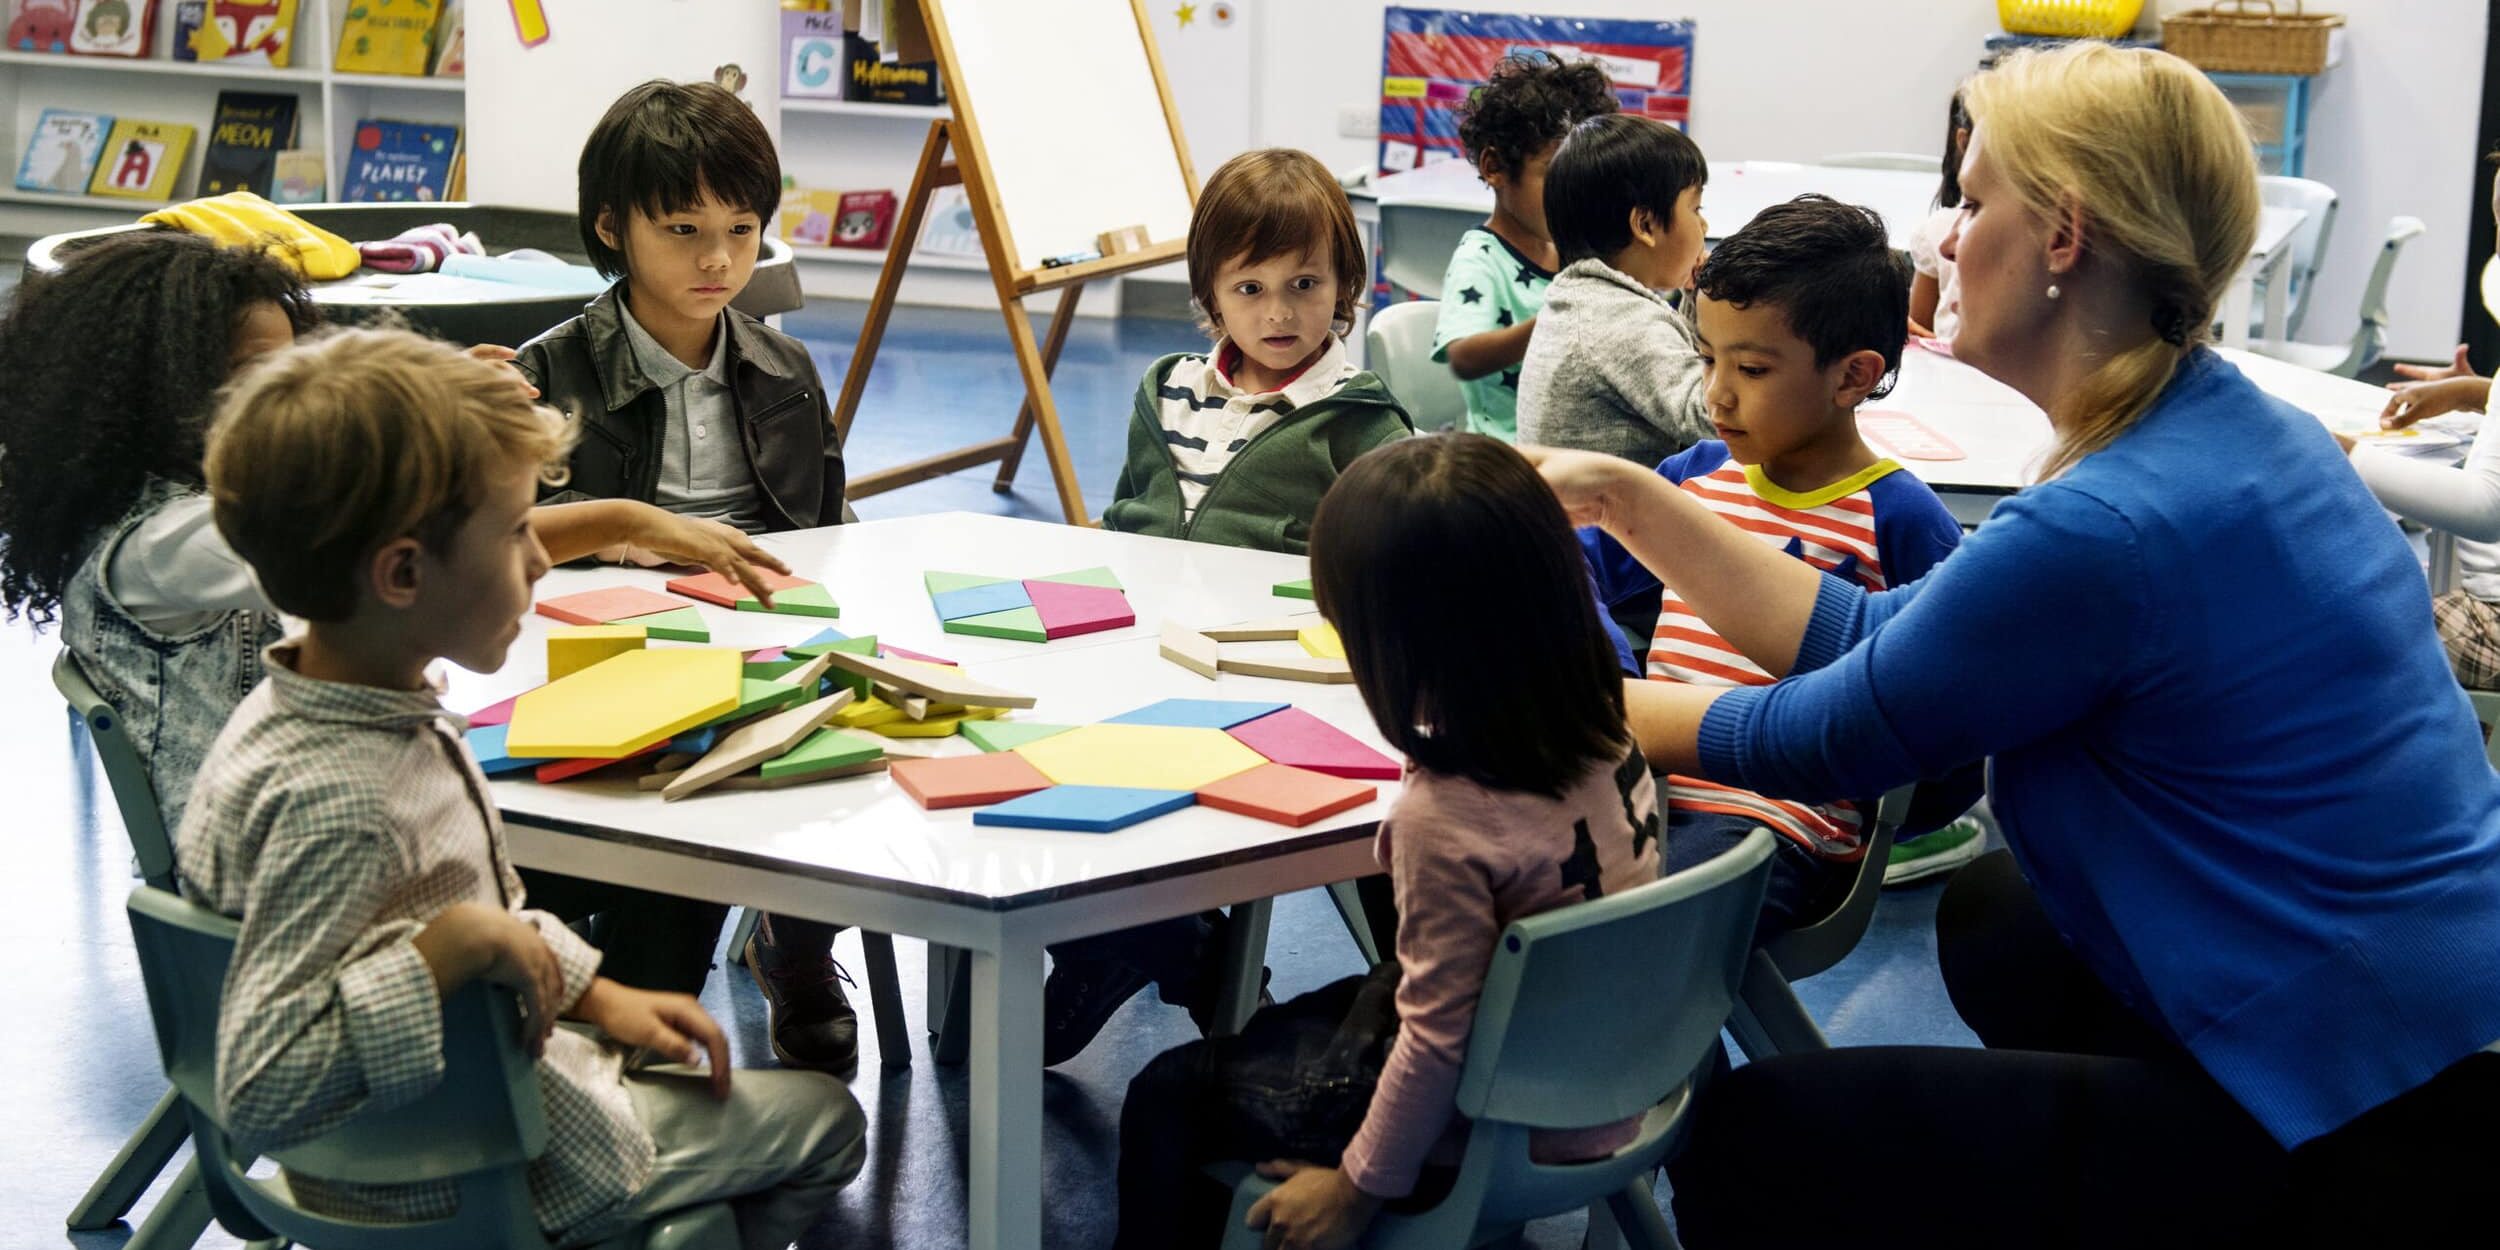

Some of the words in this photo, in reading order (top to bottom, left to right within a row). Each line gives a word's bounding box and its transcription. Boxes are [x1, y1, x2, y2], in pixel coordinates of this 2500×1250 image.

[798, 40, 834, 88] C
[117, 146, 150, 187] A
[361, 161, 428, 184] PLANET
